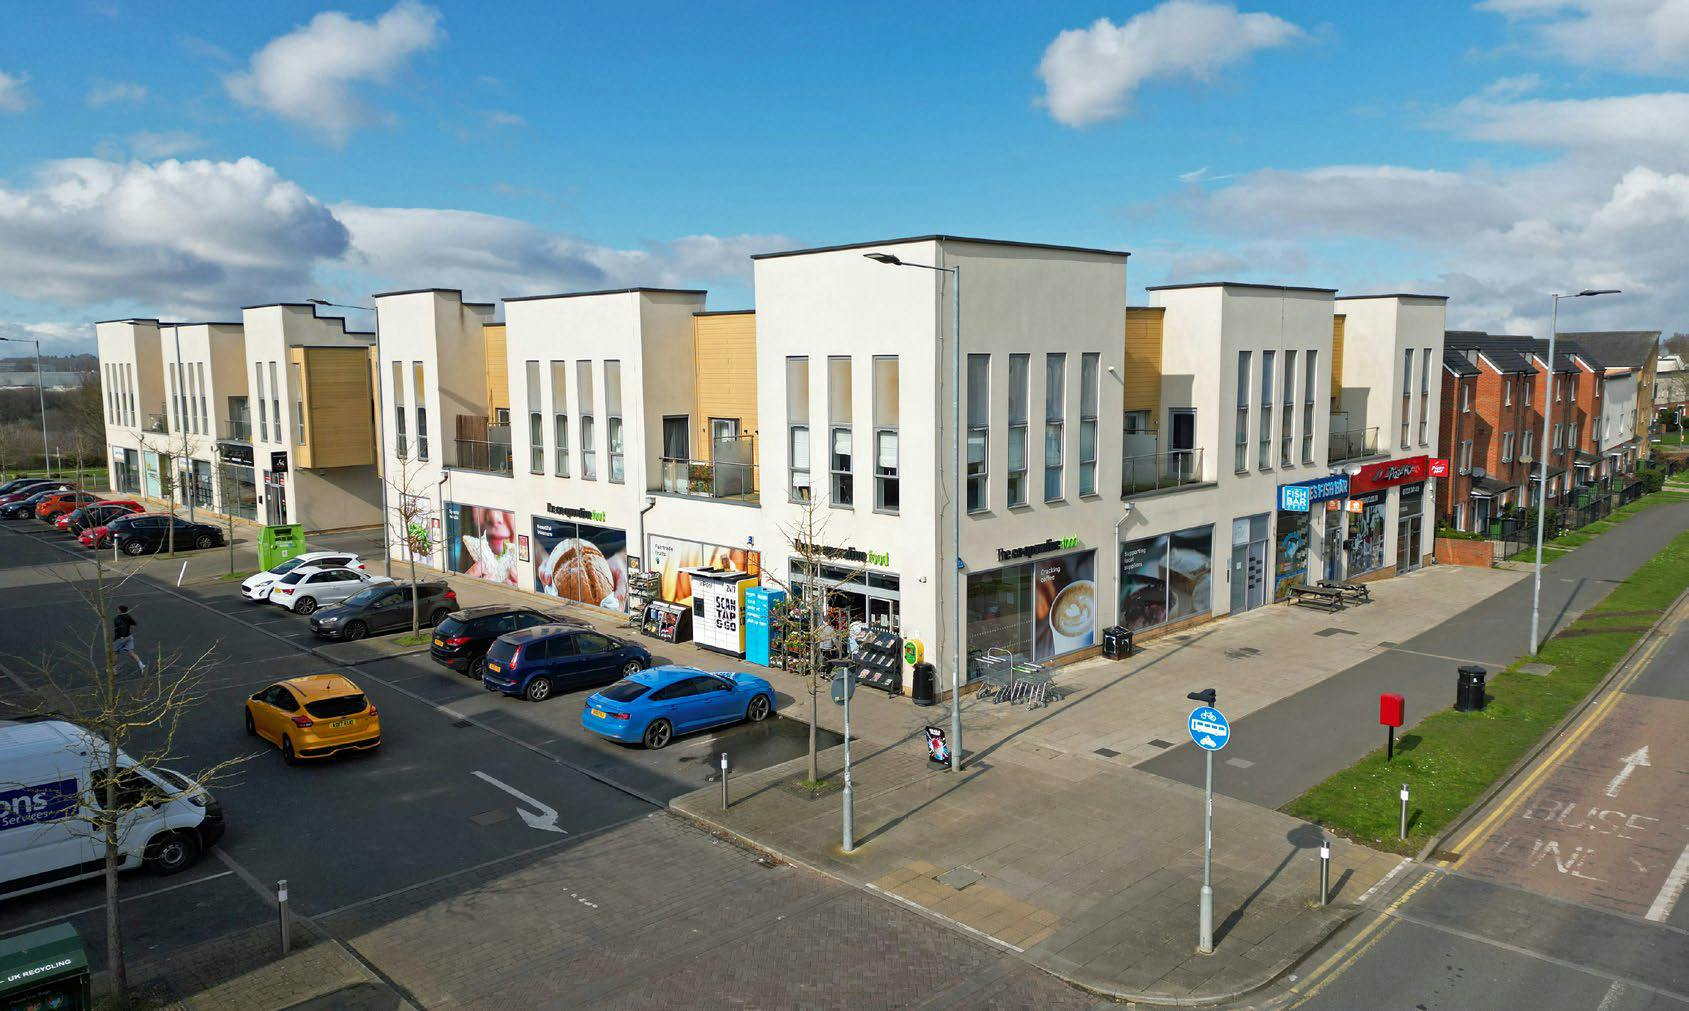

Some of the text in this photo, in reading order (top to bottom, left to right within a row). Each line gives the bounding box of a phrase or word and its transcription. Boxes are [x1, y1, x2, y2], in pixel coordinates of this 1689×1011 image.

[1287, 489, 1307, 498] FISH
[1318, 481, 1334, 498] FISH
[1334, 478, 1348, 495] BAR
[1286, 497, 1307, 506] BAR
[654, 543, 674, 552] Fairtrade
[997, 548, 1011, 562] The
[1061, 533, 1078, 550] food
[1124, 547, 1147, 557] Supporting
[868, 550, 889, 567] food
[1040, 565, 1061, 576] Cracking
[1040, 575, 1056, 583] coffee
[716, 595, 736, 611] SCAN
[716, 608, 736, 621] TAP
[2, 811, 48, 827] Services
[7, 958, 72, 982] UK RECYCLING
